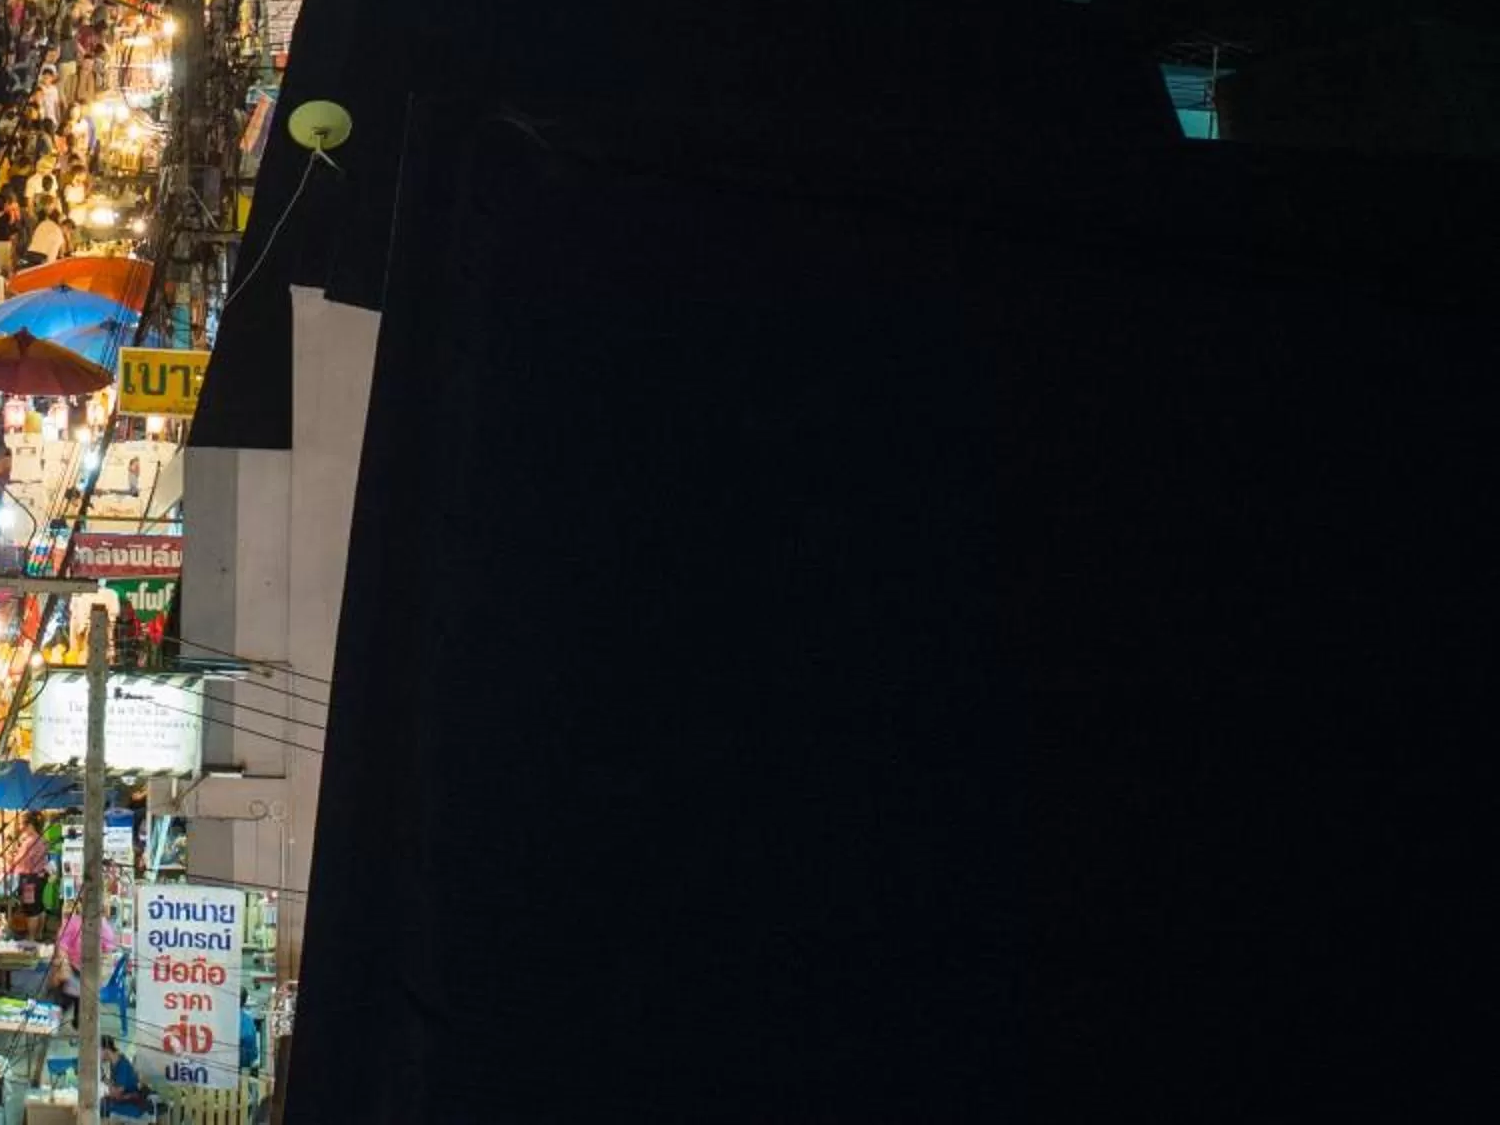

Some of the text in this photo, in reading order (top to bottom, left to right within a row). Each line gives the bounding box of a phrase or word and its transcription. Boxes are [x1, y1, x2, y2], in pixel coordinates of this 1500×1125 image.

[148, 894, 235, 924] จำหน่าย
[148, 927, 231, 952] อุปกรณ์
[152, 955, 226, 985] มือถือ
[163, 992, 213, 1011] ราคา
[163, 1015, 213, 1054] ส่ง
